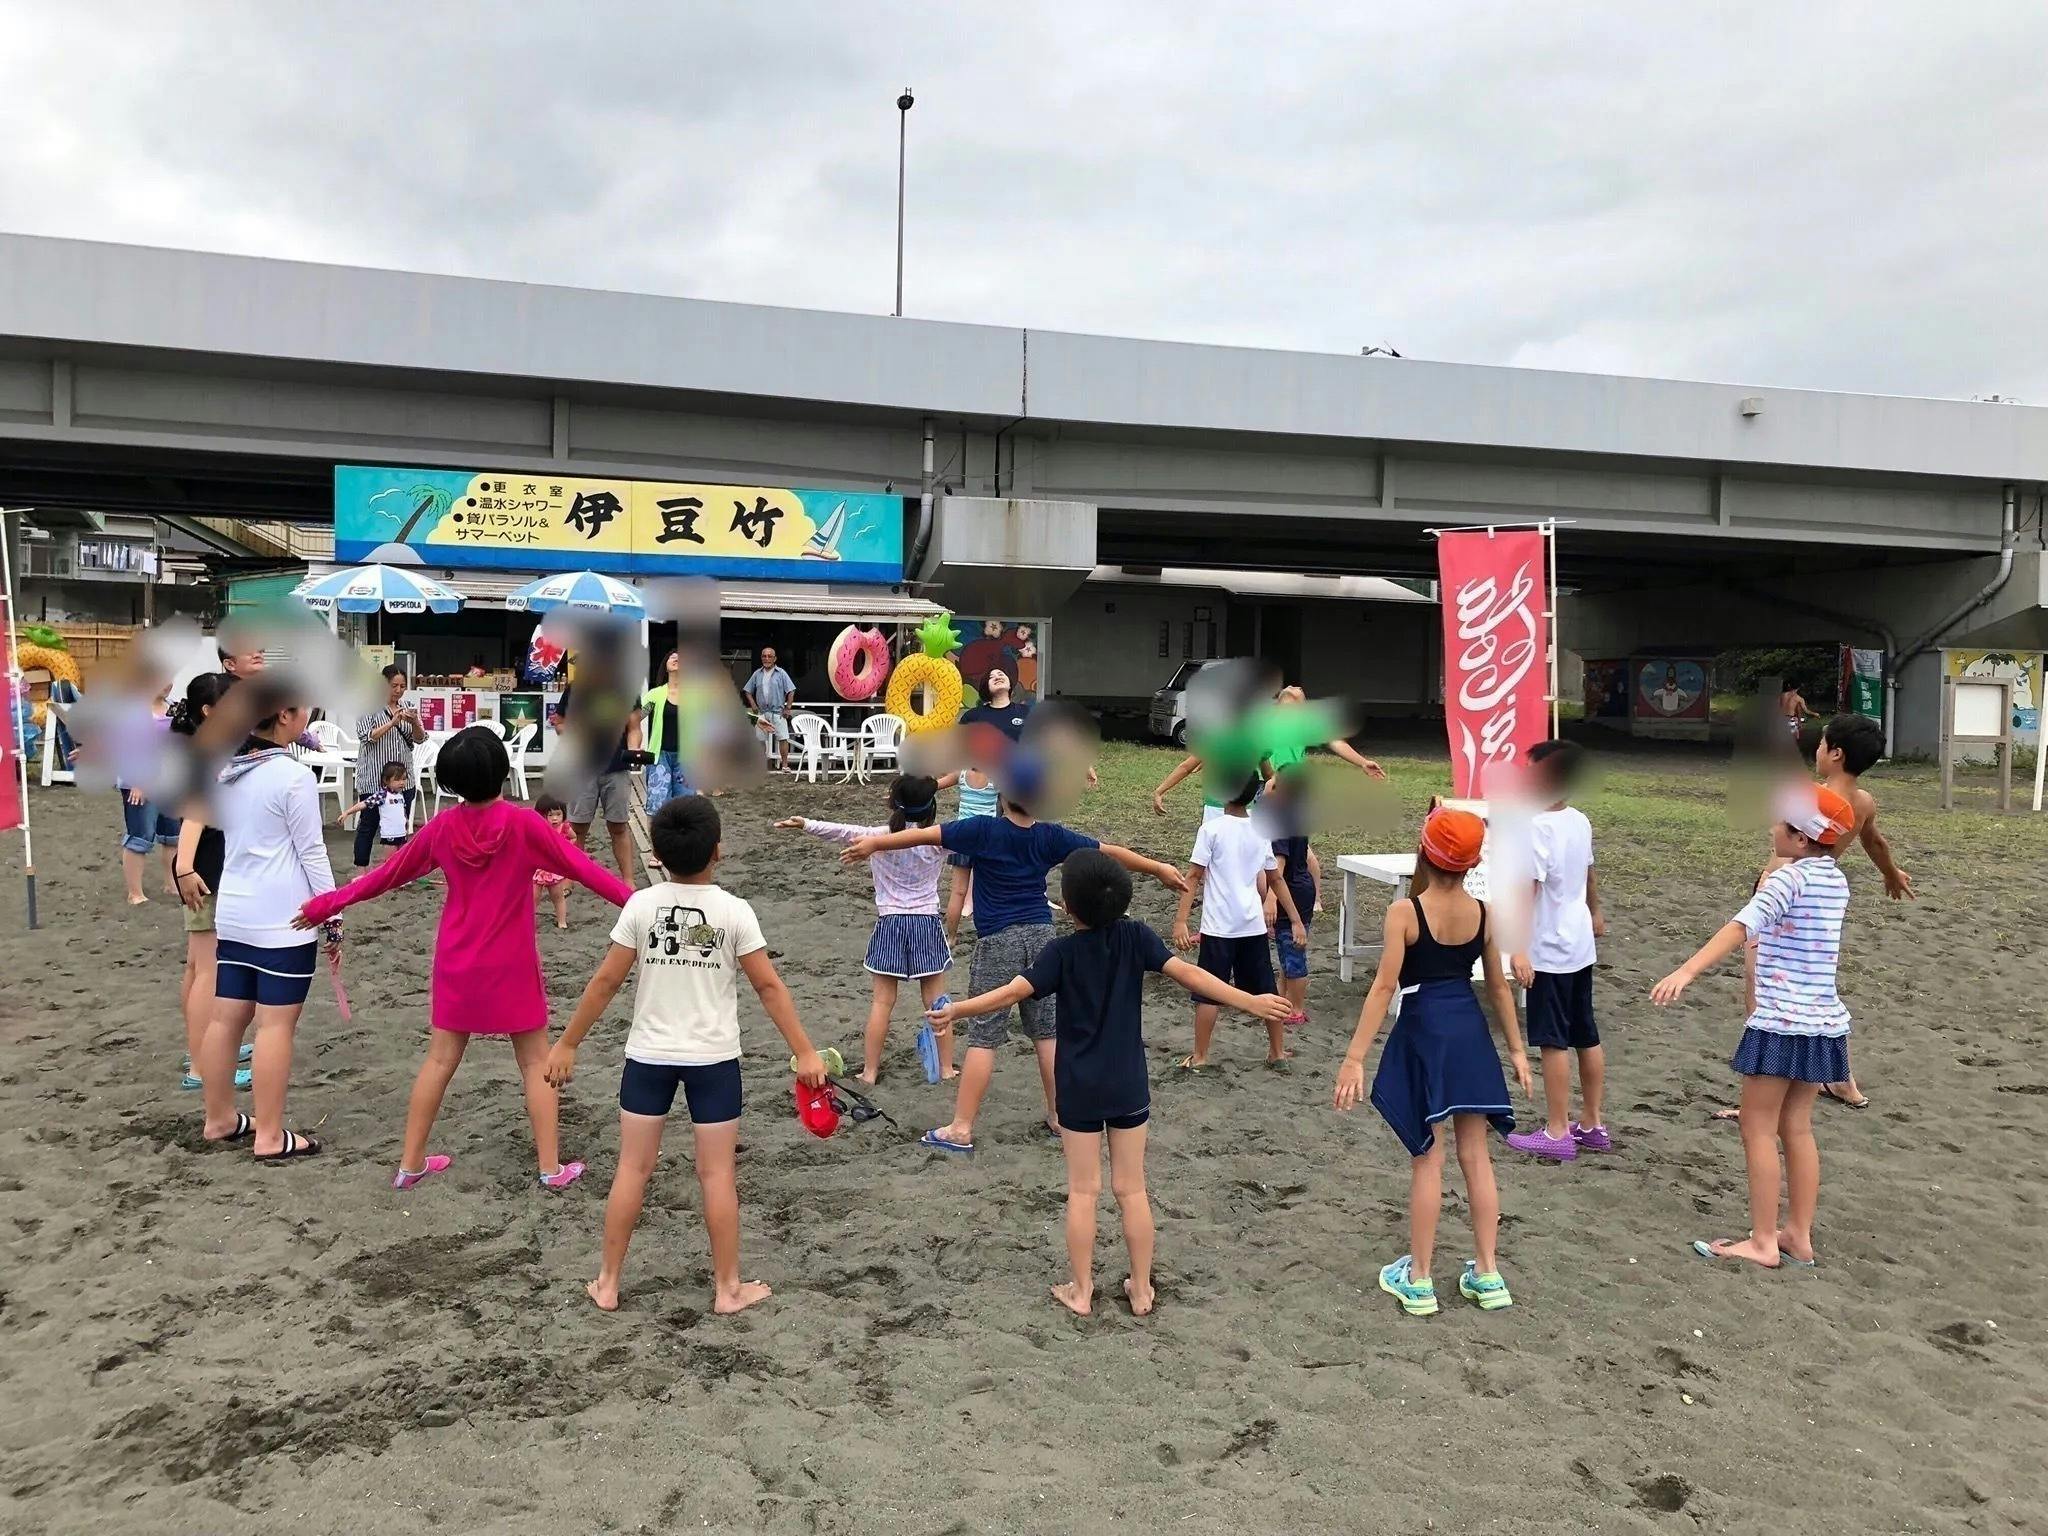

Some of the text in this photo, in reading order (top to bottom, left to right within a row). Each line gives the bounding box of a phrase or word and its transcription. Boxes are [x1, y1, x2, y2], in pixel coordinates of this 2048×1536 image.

[479, 497, 562, 511] 温水シャワー
[564, 492, 784, 547] 伊豆竹
